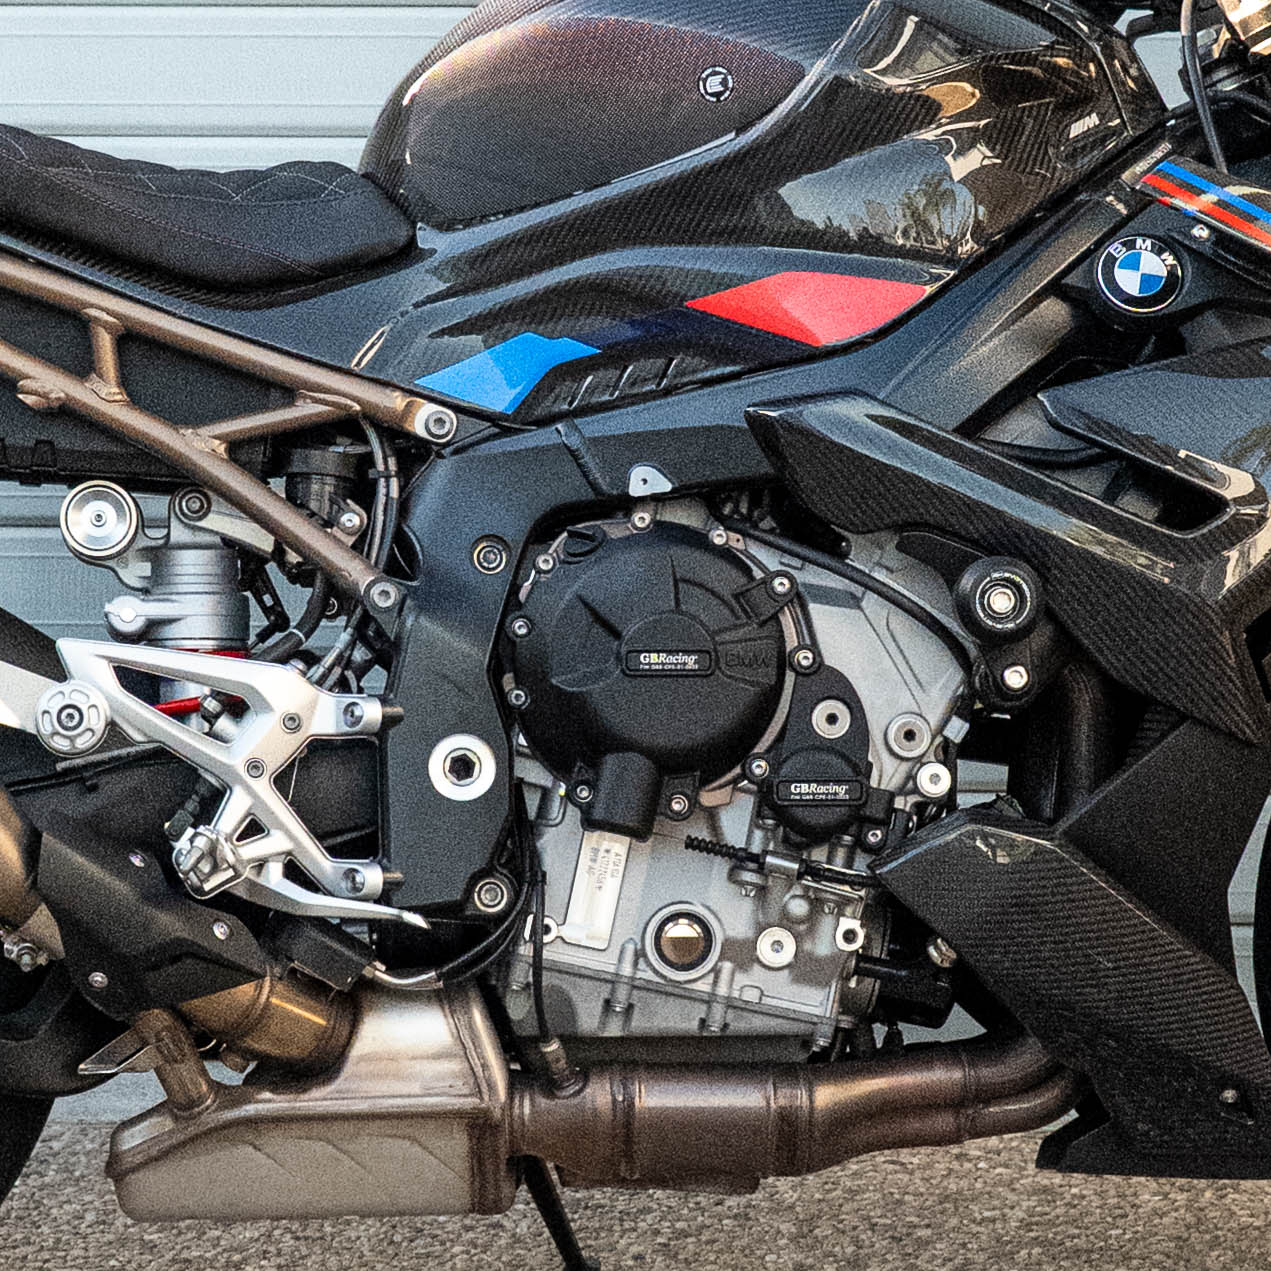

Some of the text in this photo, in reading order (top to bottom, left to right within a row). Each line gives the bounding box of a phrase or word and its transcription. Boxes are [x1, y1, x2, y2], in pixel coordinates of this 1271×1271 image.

[1110, 237, 1177, 271] BMW
[640, 652, 696, 665] GBRacing
[790, 783, 847, 795] GBRacing
